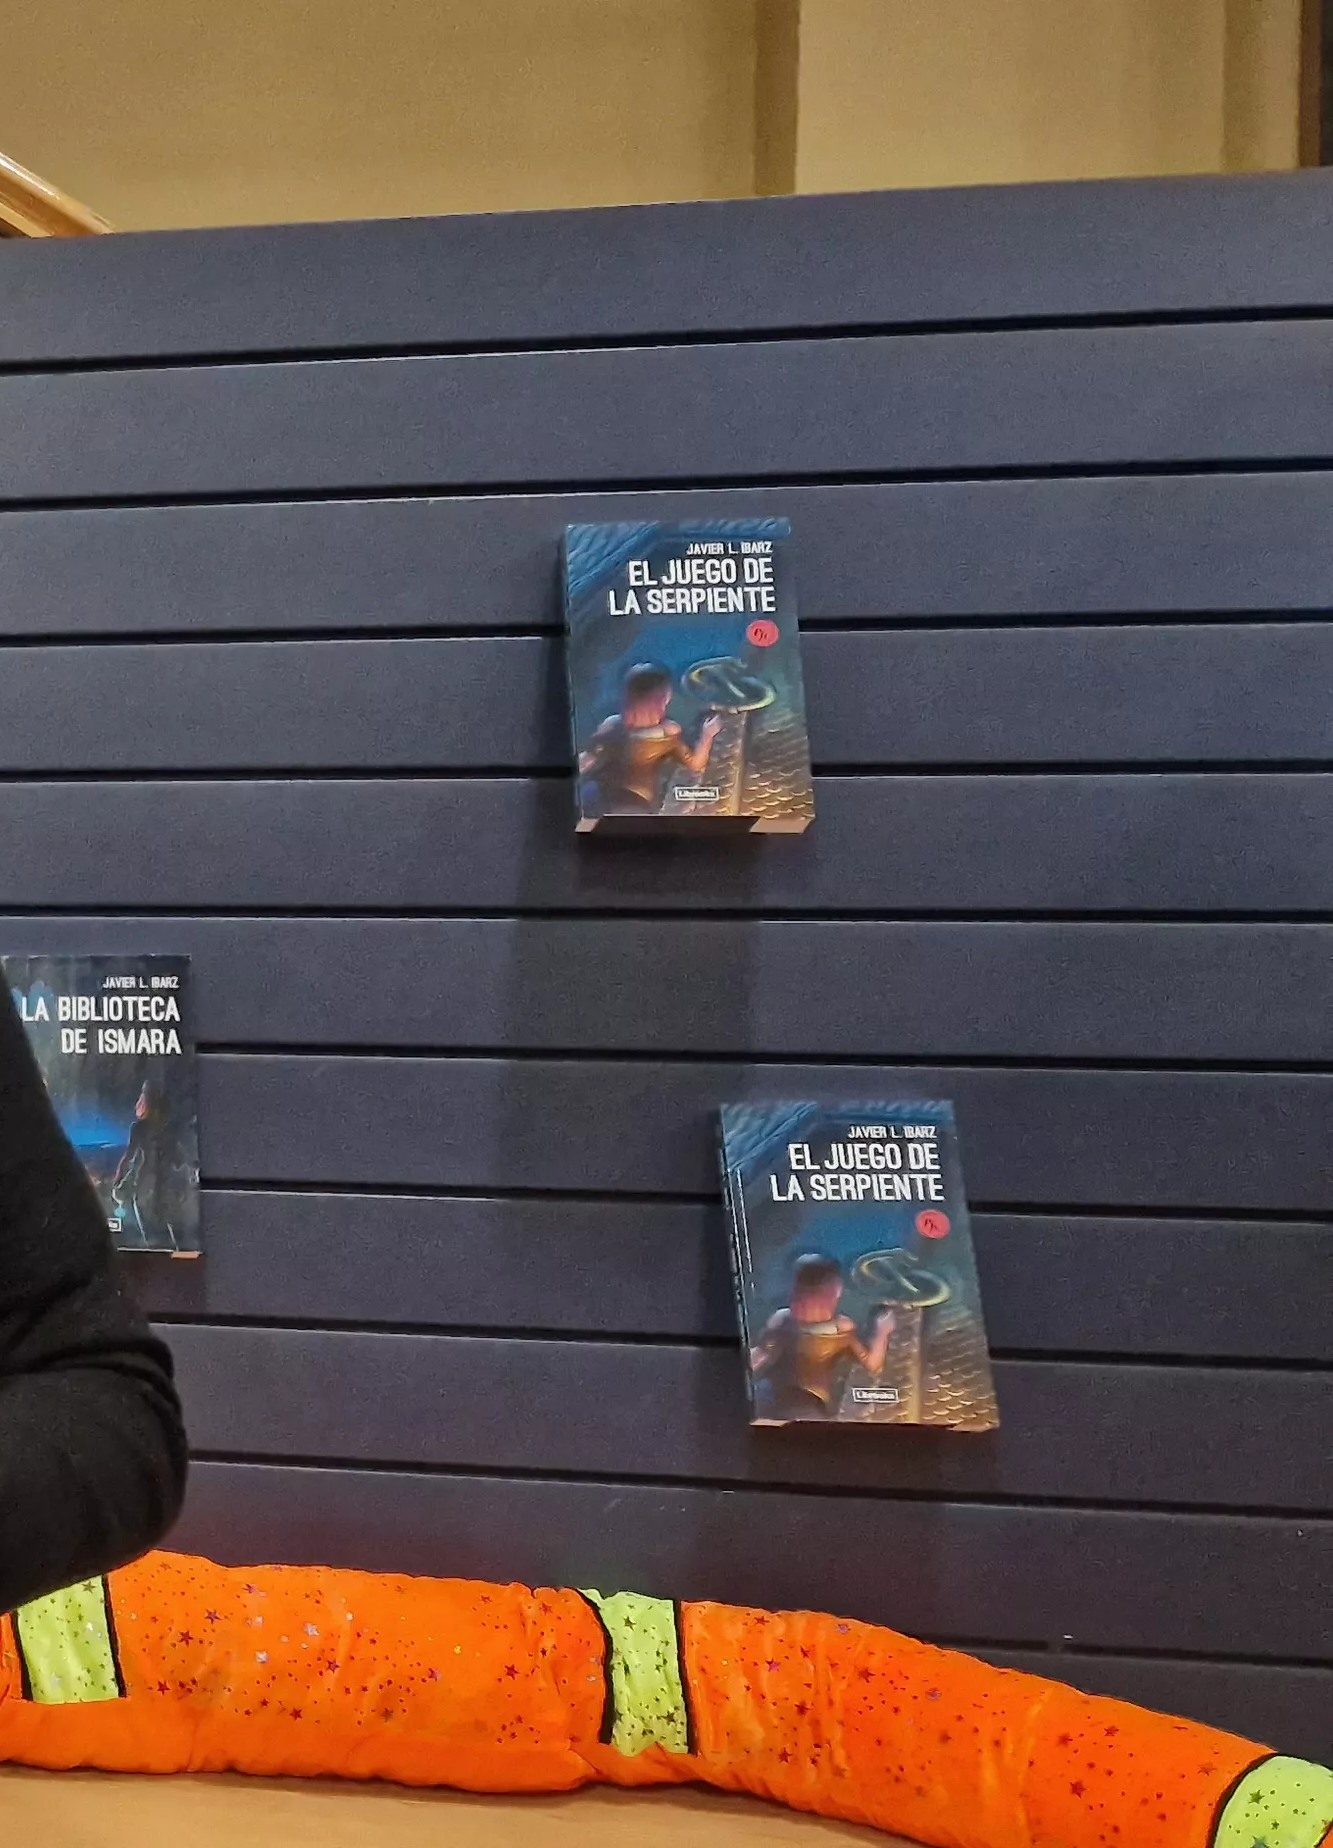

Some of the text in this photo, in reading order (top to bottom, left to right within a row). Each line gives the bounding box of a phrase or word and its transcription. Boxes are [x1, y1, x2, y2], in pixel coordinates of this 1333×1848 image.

[686, 541, 773, 555] JAVIER L. IBARZ
[628, 557, 774, 586] EL JUEGO DE
[608, 587, 776, 616] LA SERPIENTE
[103, 976, 179, 989] JAVIER L. IBARZ
[21, 996, 180, 1022] LA BIBLIOTECA
[61, 1029, 182, 1054] DE ISMARA
[848, 1125, 937, 1139] JAVIER L. IBARZ
[788, 1143, 941, 1171] EL JUEGO DE
[770, 1173, 945, 1202] LA SERPIENTE
